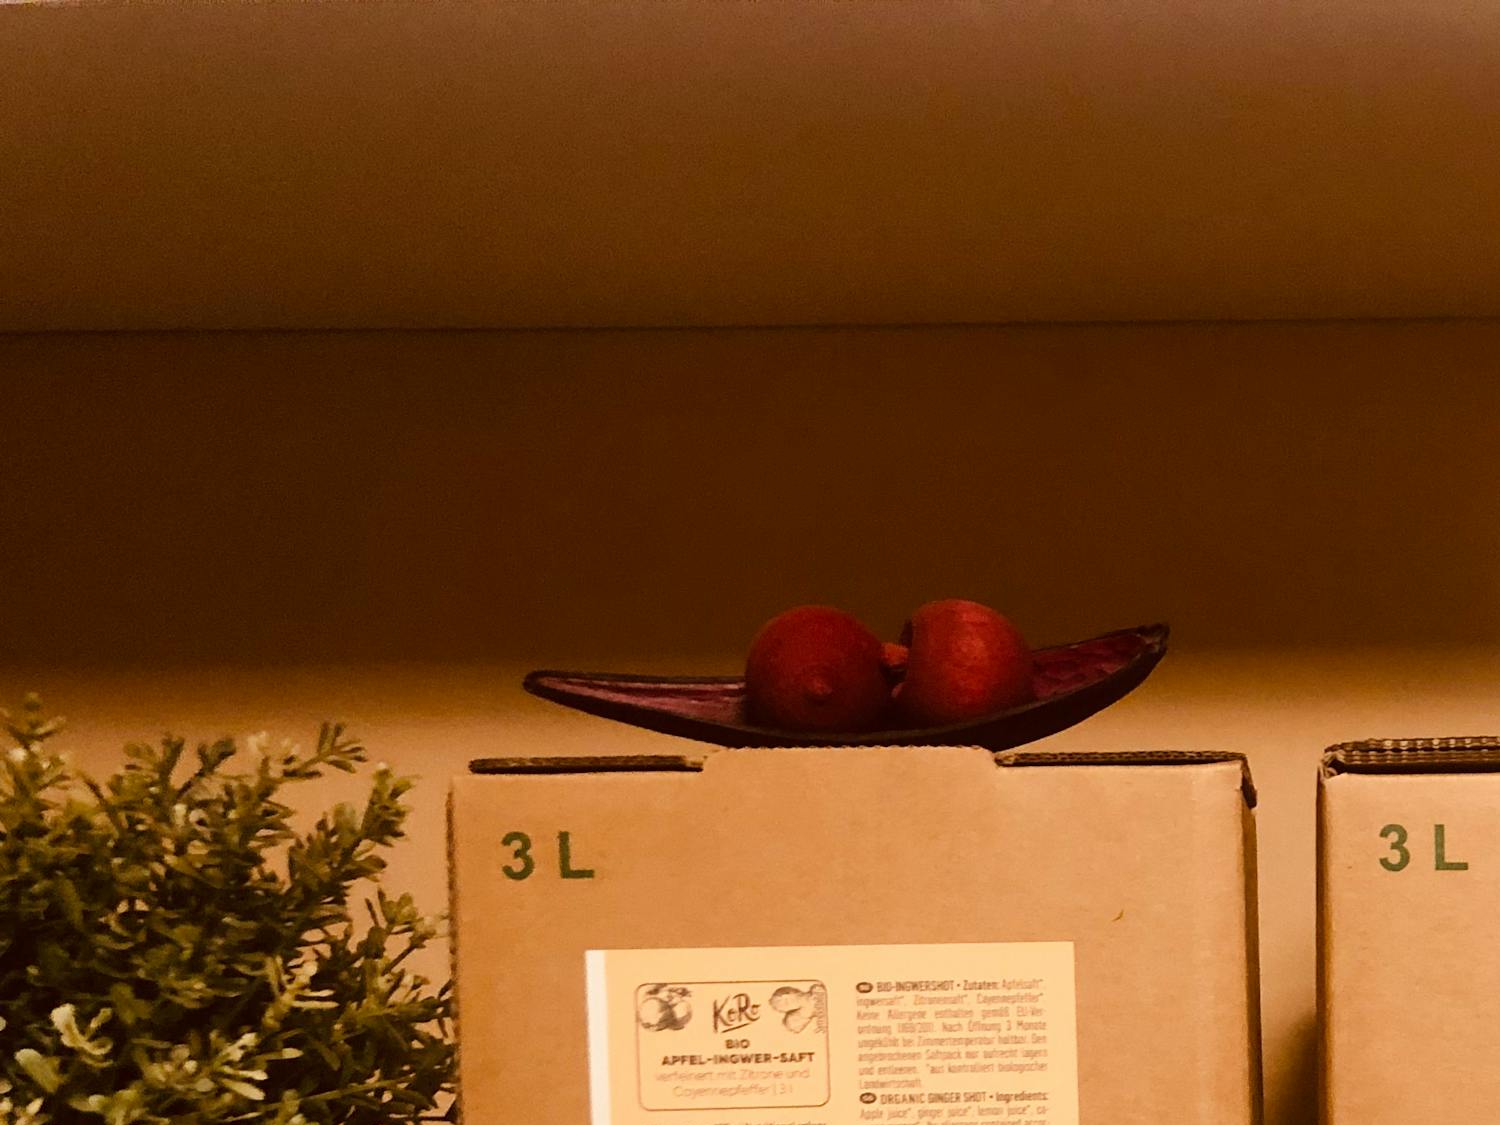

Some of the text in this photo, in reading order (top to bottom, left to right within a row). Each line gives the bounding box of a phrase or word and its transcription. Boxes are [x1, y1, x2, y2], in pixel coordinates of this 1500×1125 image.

[502, 832, 594, 880] 3 L
[1380, 824, 1468, 872] 3 L
[661, 1052, 814, 1065] APFEL-INGWER-SAFT
[724, 1039, 750, 1049] BIO
